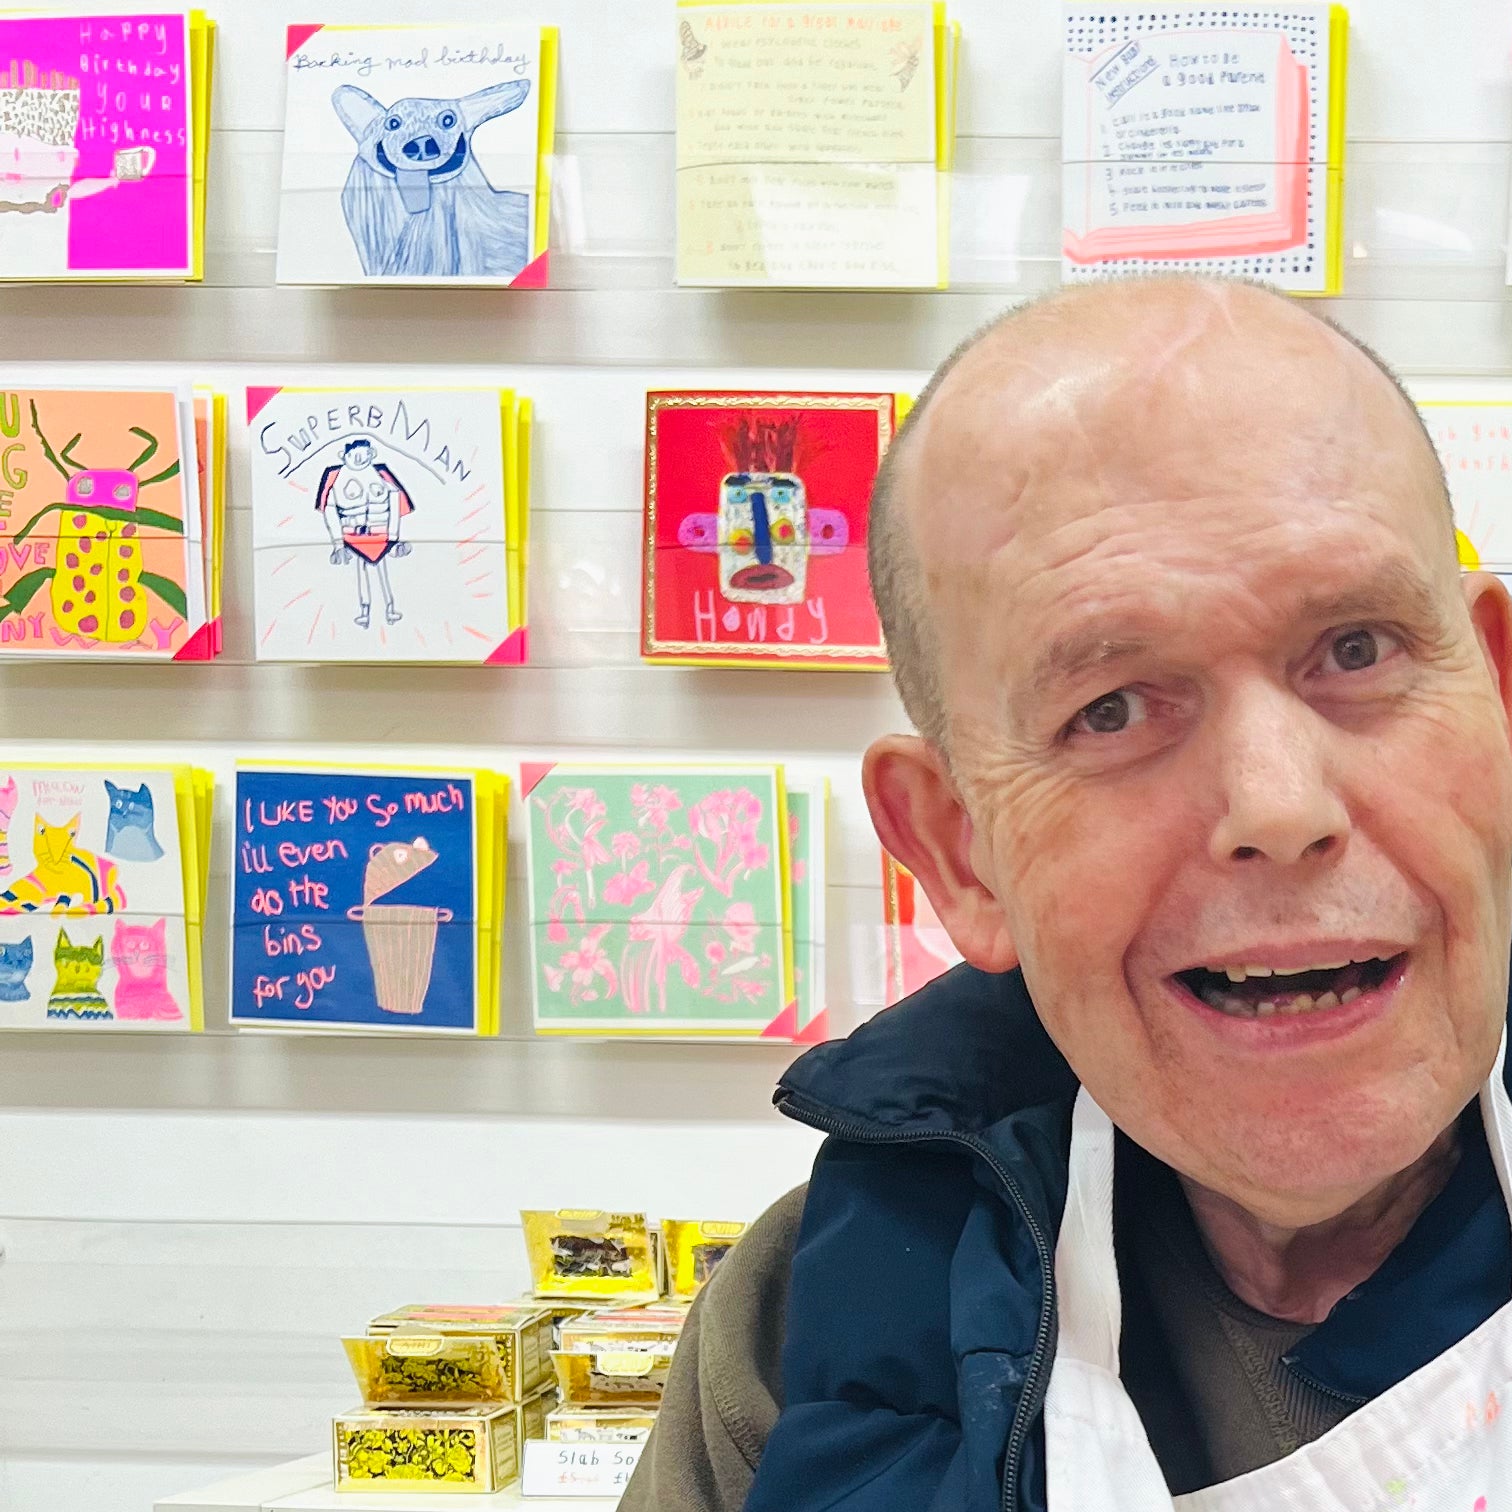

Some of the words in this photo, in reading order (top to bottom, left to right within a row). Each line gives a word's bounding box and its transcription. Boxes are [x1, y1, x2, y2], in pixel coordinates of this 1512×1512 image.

[80, 22, 167, 55] Happy
[80, 54, 179, 84] Birthday
[294, 52, 382, 76] Barking
[386, 48, 427, 70] mad
[434, 44, 531, 75] birthday
[80, 117, 185, 146] Highness
[245, 798, 254, 833] I
[260, 799, 313, 826] LIKE
[323, 795, 357, 824] YOU
[366, 794, 398, 828] So
[404, 784, 465, 813] much
[278, 838, 349, 868] even
[251, 888, 284, 916] do
[289, 873, 330, 909] the
[264, 924, 322, 956] bins
[253, 975, 291, 1008] for
[295, 964, 336, 1010] you
[558, 1449, 600, 1466] Slab
[611, 1450, 636, 1466] So
